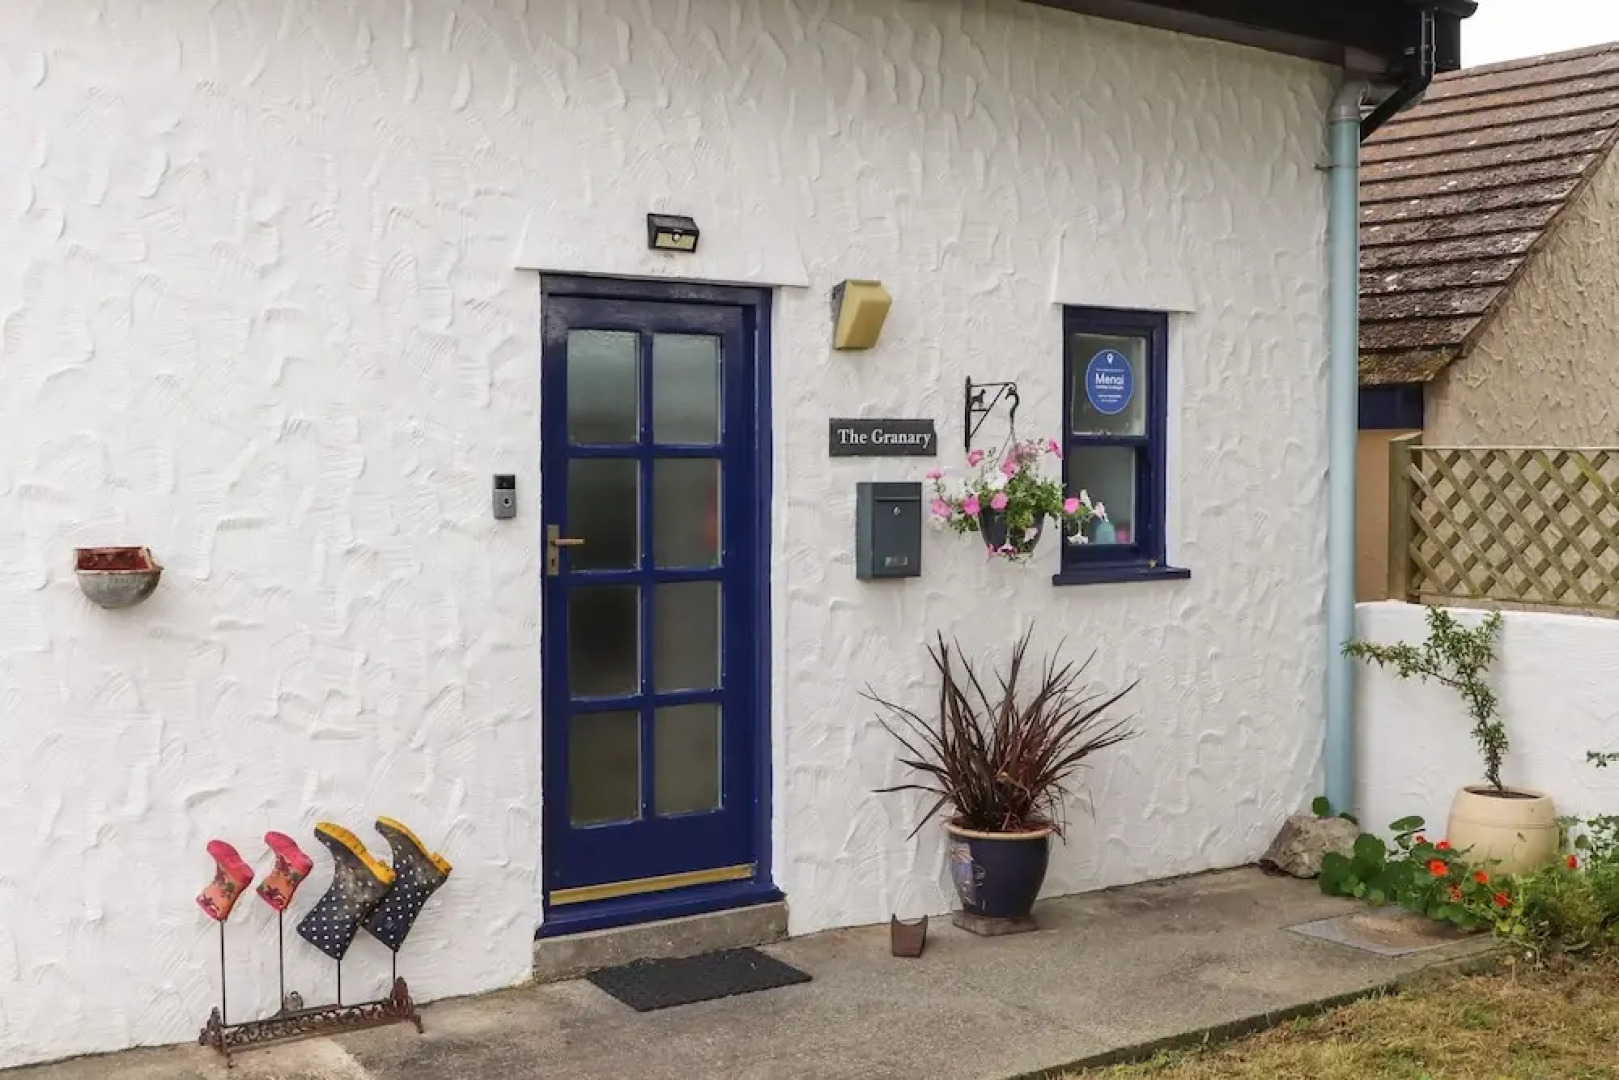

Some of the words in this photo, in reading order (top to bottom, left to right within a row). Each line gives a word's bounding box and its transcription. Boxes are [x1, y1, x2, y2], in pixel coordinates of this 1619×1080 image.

[1095, 373, 1125, 385] Menai
[837, 428, 868, 444] The
[870, 428, 932, 449] Granary
